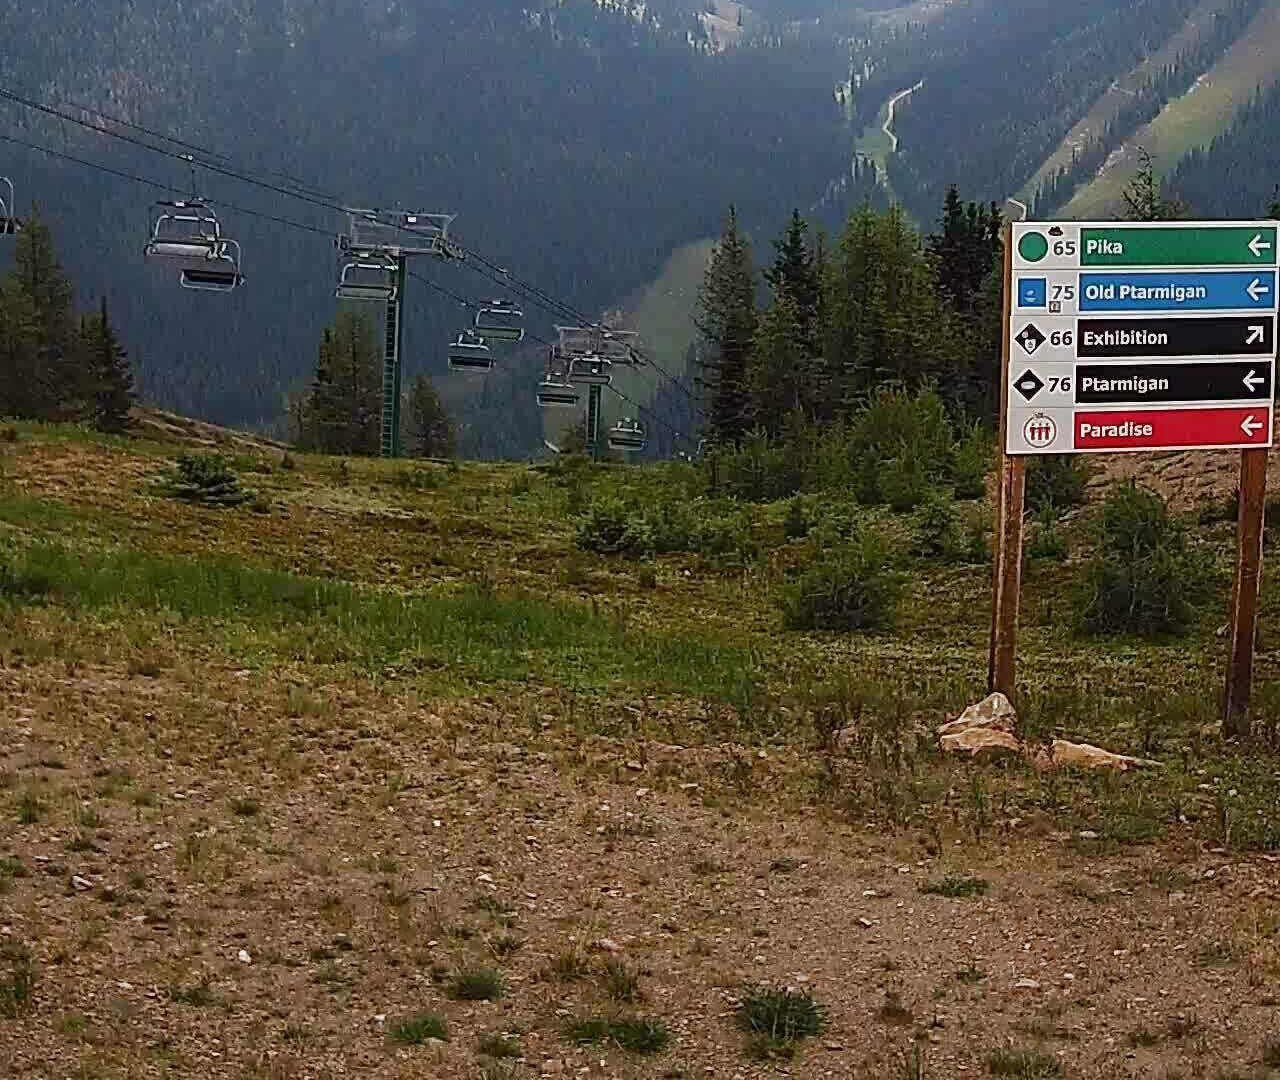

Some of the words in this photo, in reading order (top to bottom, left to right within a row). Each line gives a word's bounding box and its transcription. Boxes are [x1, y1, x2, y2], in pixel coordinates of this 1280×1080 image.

[1053, 240, 1076, 256] 65
[1086, 239, 1123, 255] Pika
[1052, 285, 1074, 300] 75
[1085, 283, 1114, 300] Old
[1119, 283, 1206, 303] Ptarmigan
[1050, 331, 1072, 346] 66
[1083, 330, 1168, 346] Exhibition
[1048, 377, 1071, 392] 76
[1082, 376, 1169, 395] Ptarmigan
[1080, 421, 1153, 438] Paradise
